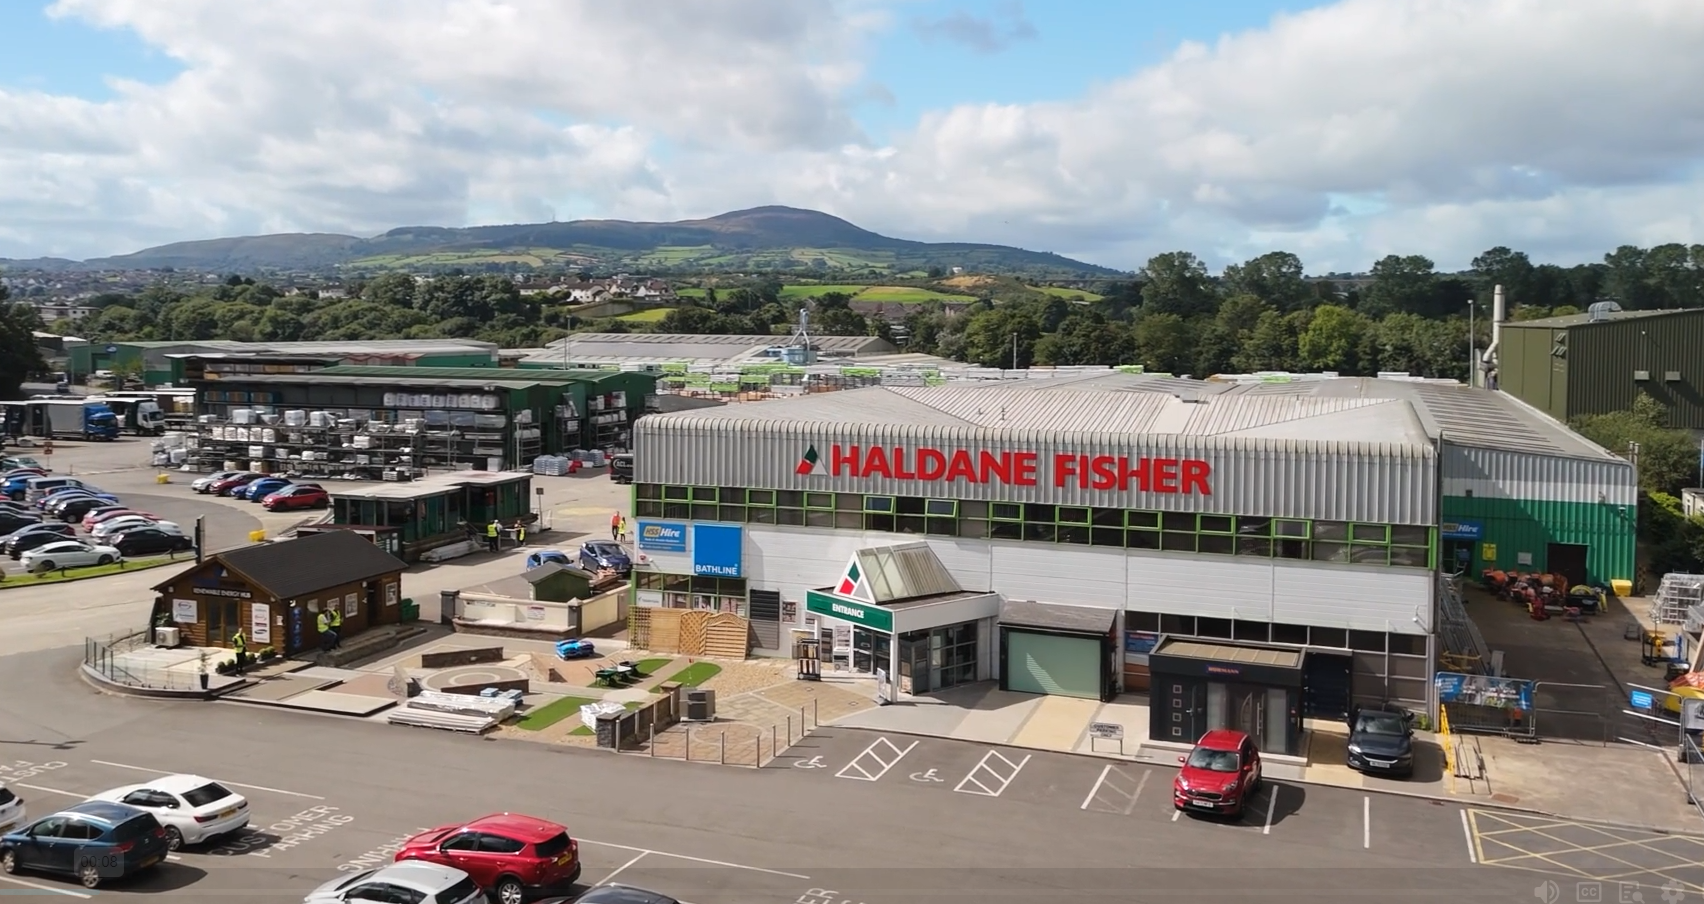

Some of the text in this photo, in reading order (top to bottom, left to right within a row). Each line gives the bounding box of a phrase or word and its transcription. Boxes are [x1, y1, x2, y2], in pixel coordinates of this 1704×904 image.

[831, 444, 1211, 495] HALDANE FISHER
[660, 528, 680, 537] Hire
[1458, 524, 1478, 533] Hire
[695, 564, 738, 575] BATHLINE
[832, 603, 865, 618] ENTRANCE
